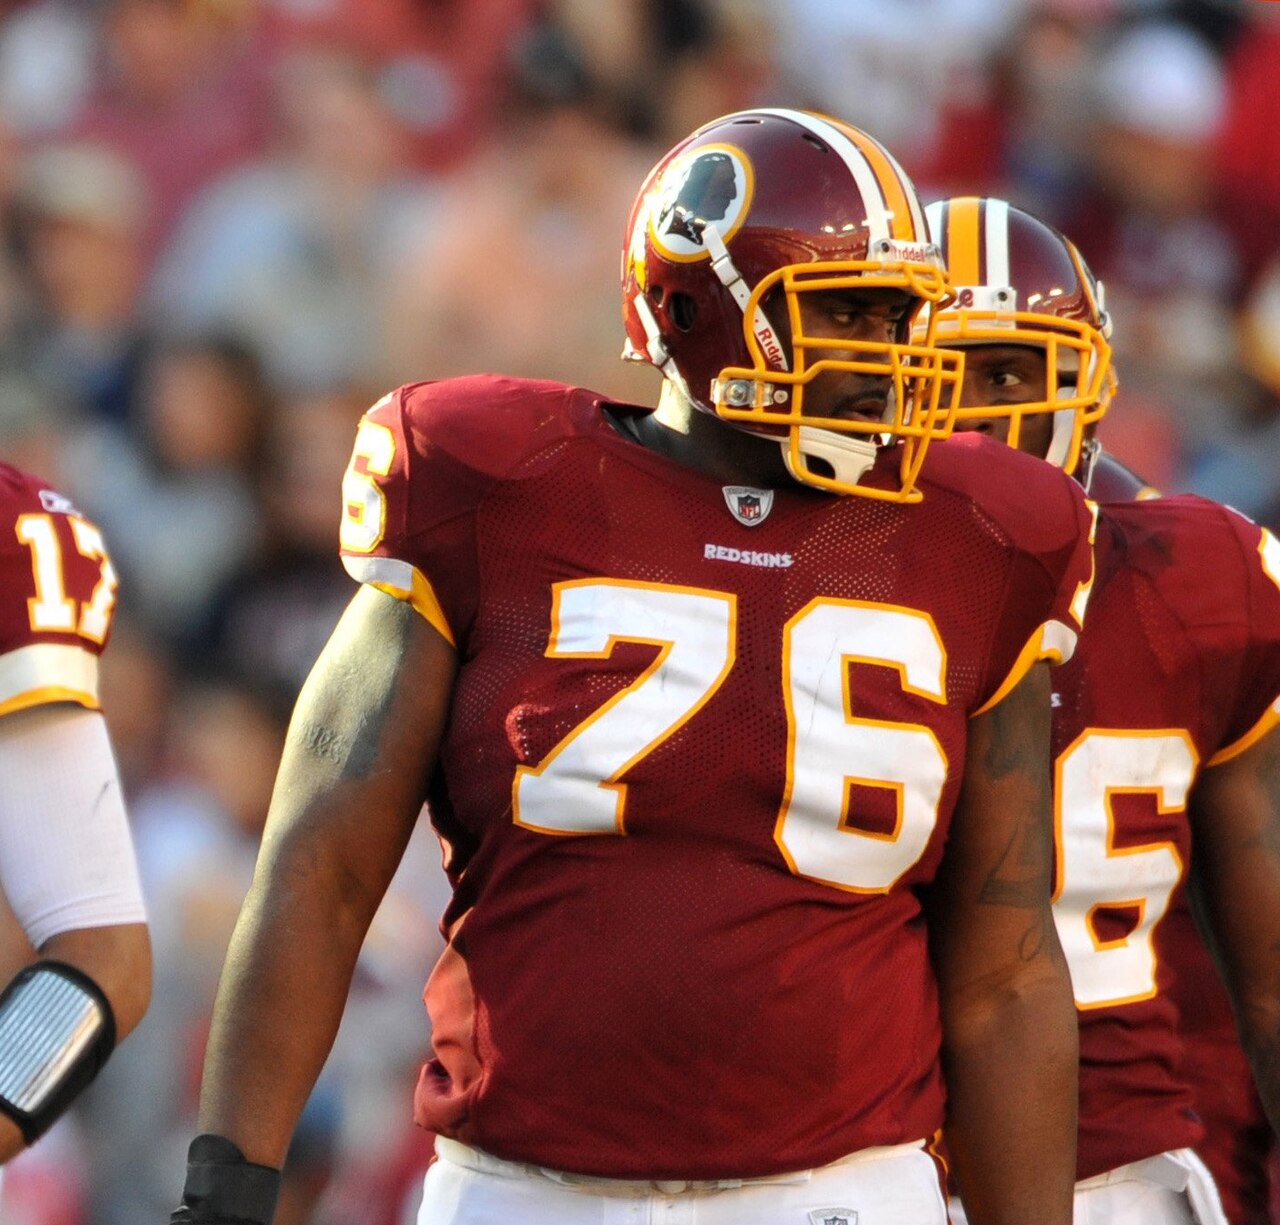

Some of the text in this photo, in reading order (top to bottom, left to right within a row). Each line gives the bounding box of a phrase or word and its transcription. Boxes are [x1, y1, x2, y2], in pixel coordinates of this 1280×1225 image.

[15, 513, 120, 645] 17
[703, 543, 795, 568] REDSKINS
[512, 577, 949, 895] 76
